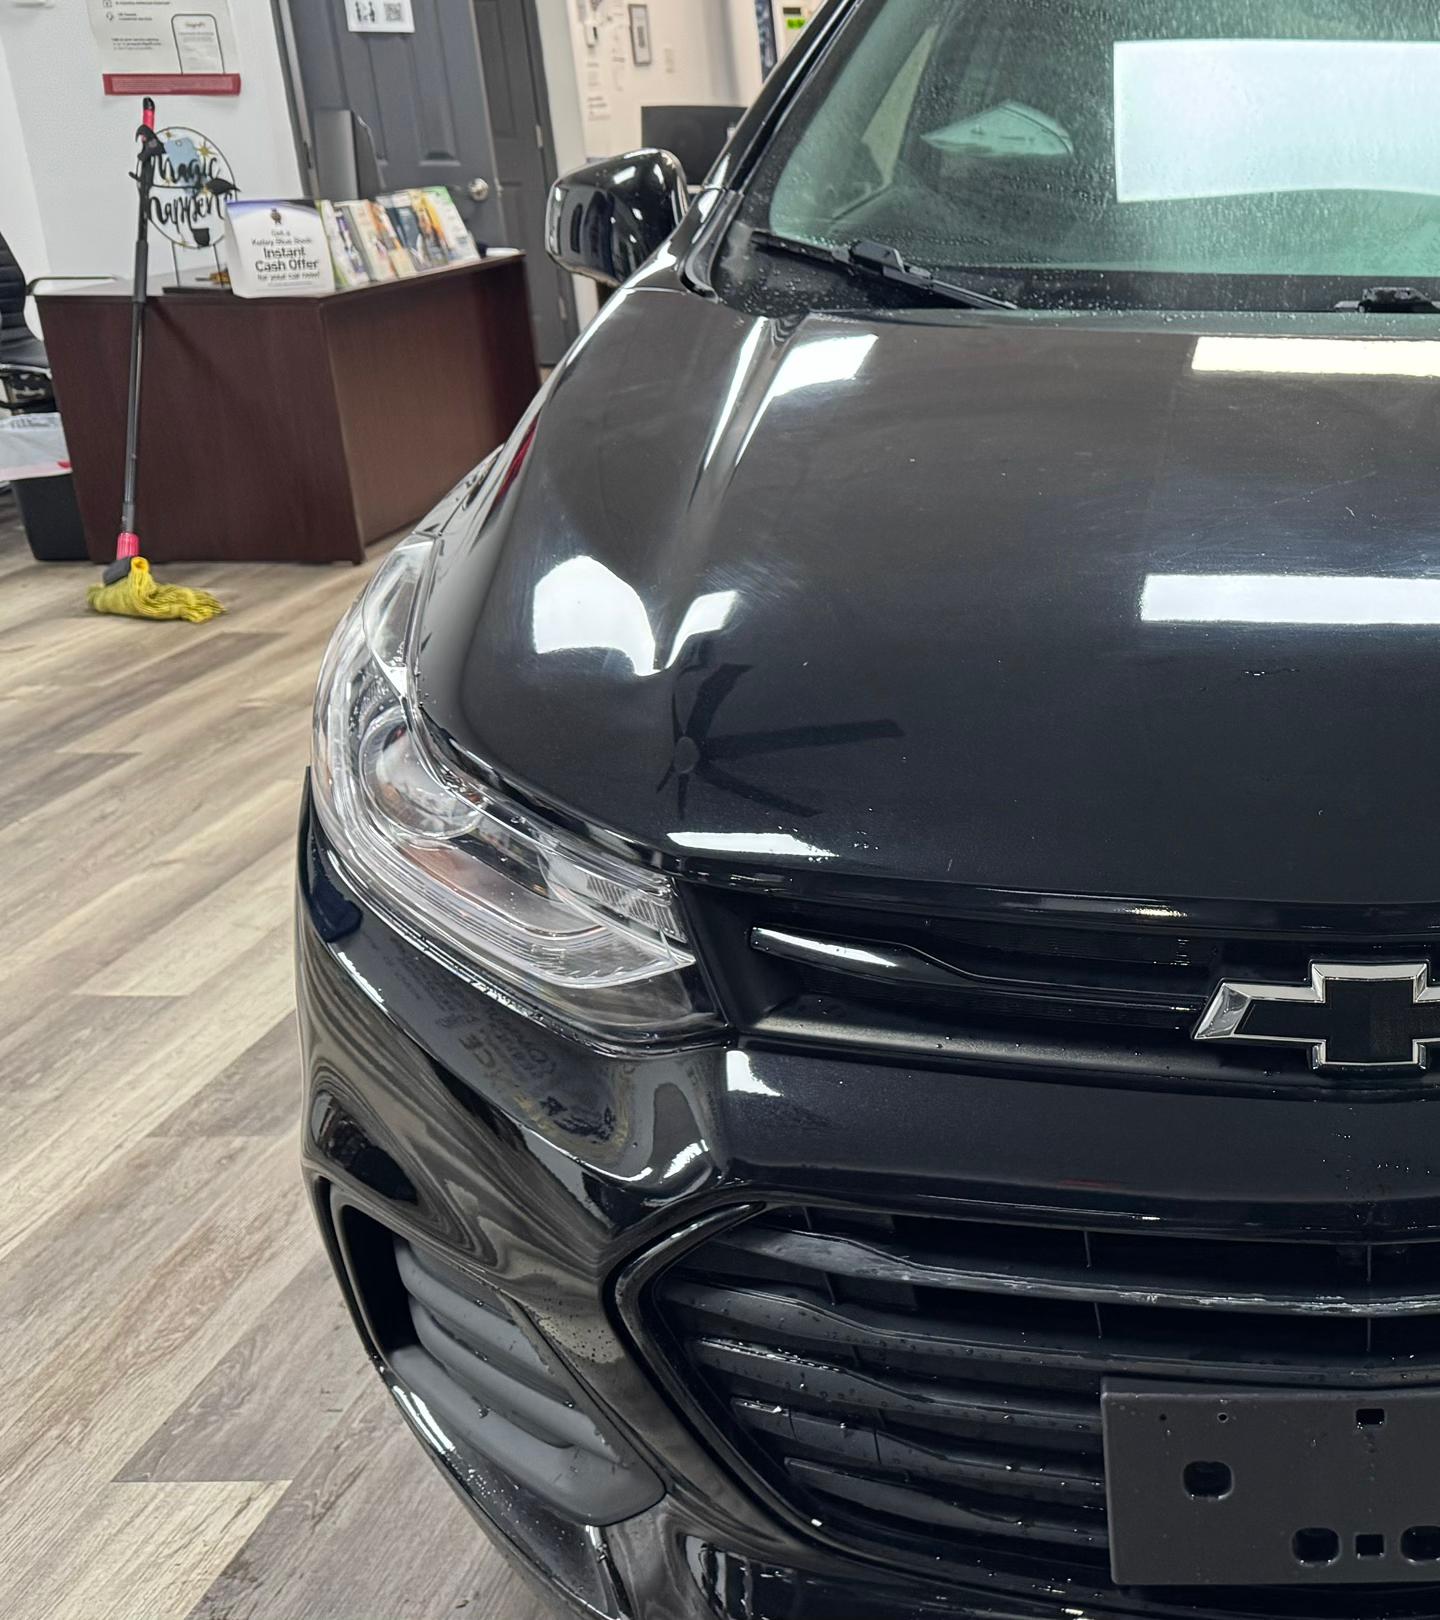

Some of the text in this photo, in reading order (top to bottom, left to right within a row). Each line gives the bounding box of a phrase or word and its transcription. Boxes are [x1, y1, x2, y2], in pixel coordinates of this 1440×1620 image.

[263, 246, 306, 258] Instant
[255, 258, 319, 272] Cash Offer
